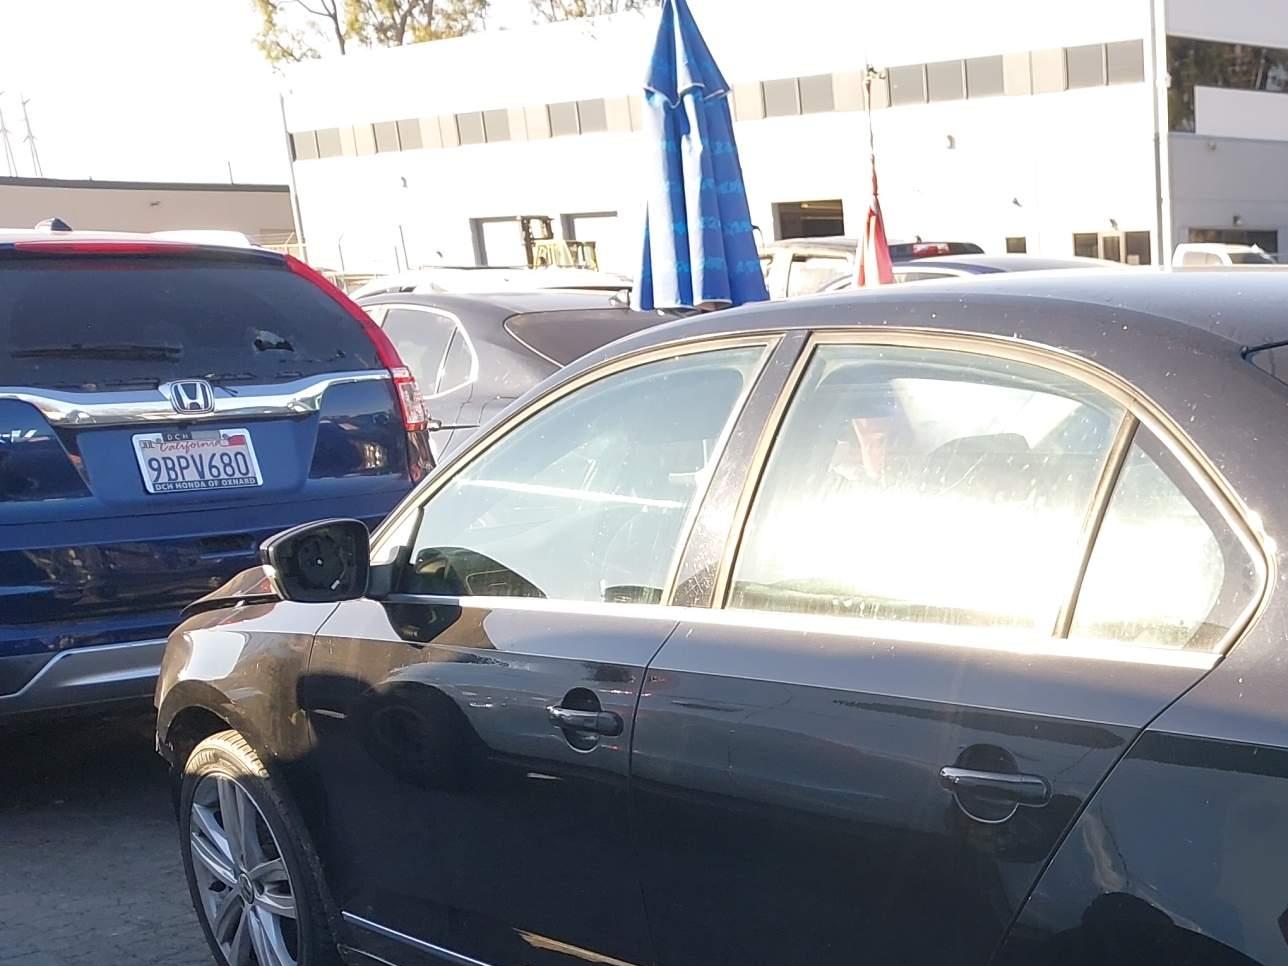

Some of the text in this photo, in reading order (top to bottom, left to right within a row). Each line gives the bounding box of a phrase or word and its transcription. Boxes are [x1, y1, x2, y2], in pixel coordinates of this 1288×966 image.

[148, 451, 250, 482] 9BPV680
[155, 478, 256, 491] DCH HONDA OF OXNARD
